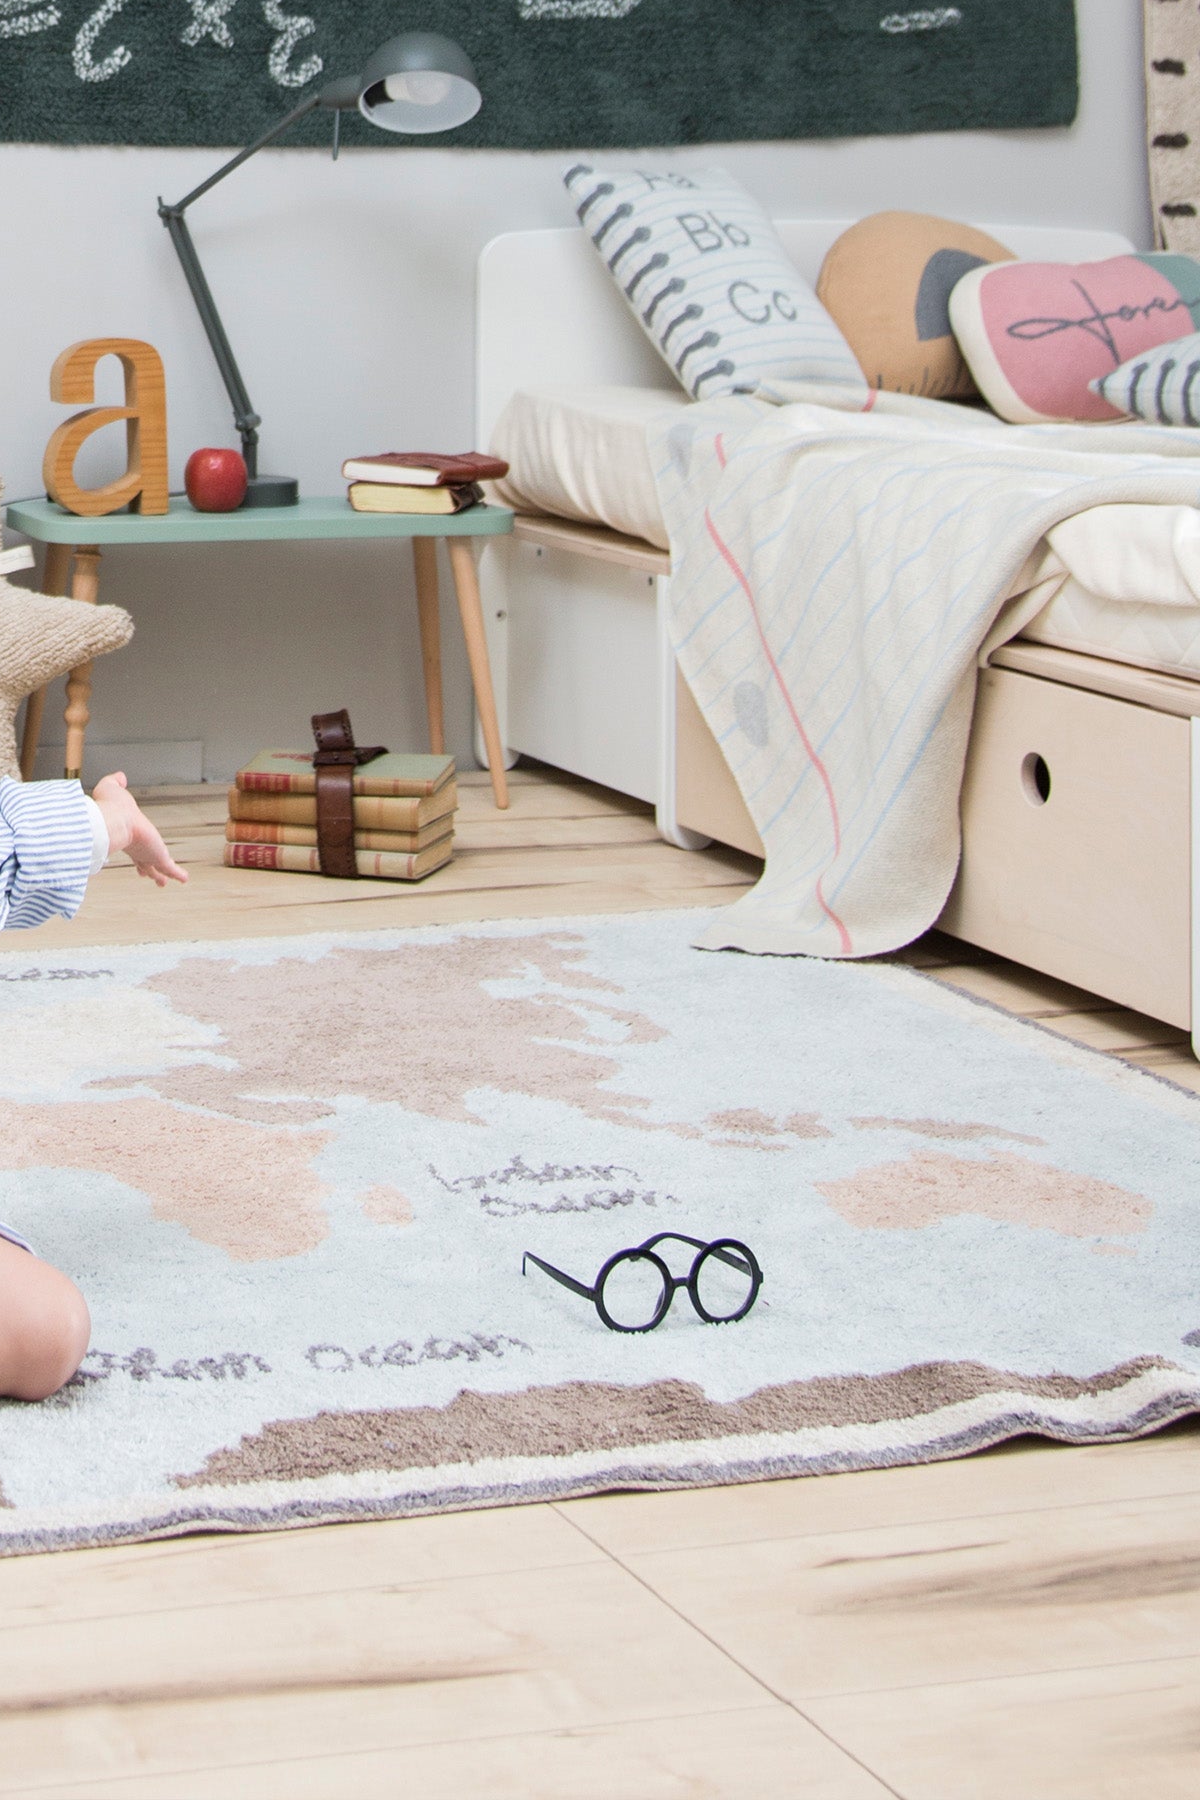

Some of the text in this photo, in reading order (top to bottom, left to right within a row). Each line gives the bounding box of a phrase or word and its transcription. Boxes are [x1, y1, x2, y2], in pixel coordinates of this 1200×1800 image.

[675, 209, 751, 254] Bb
[727, 280, 798, 325] Cc
[42, 336, 169, 516] a
[305, 1332, 535, 1374] Ocean
